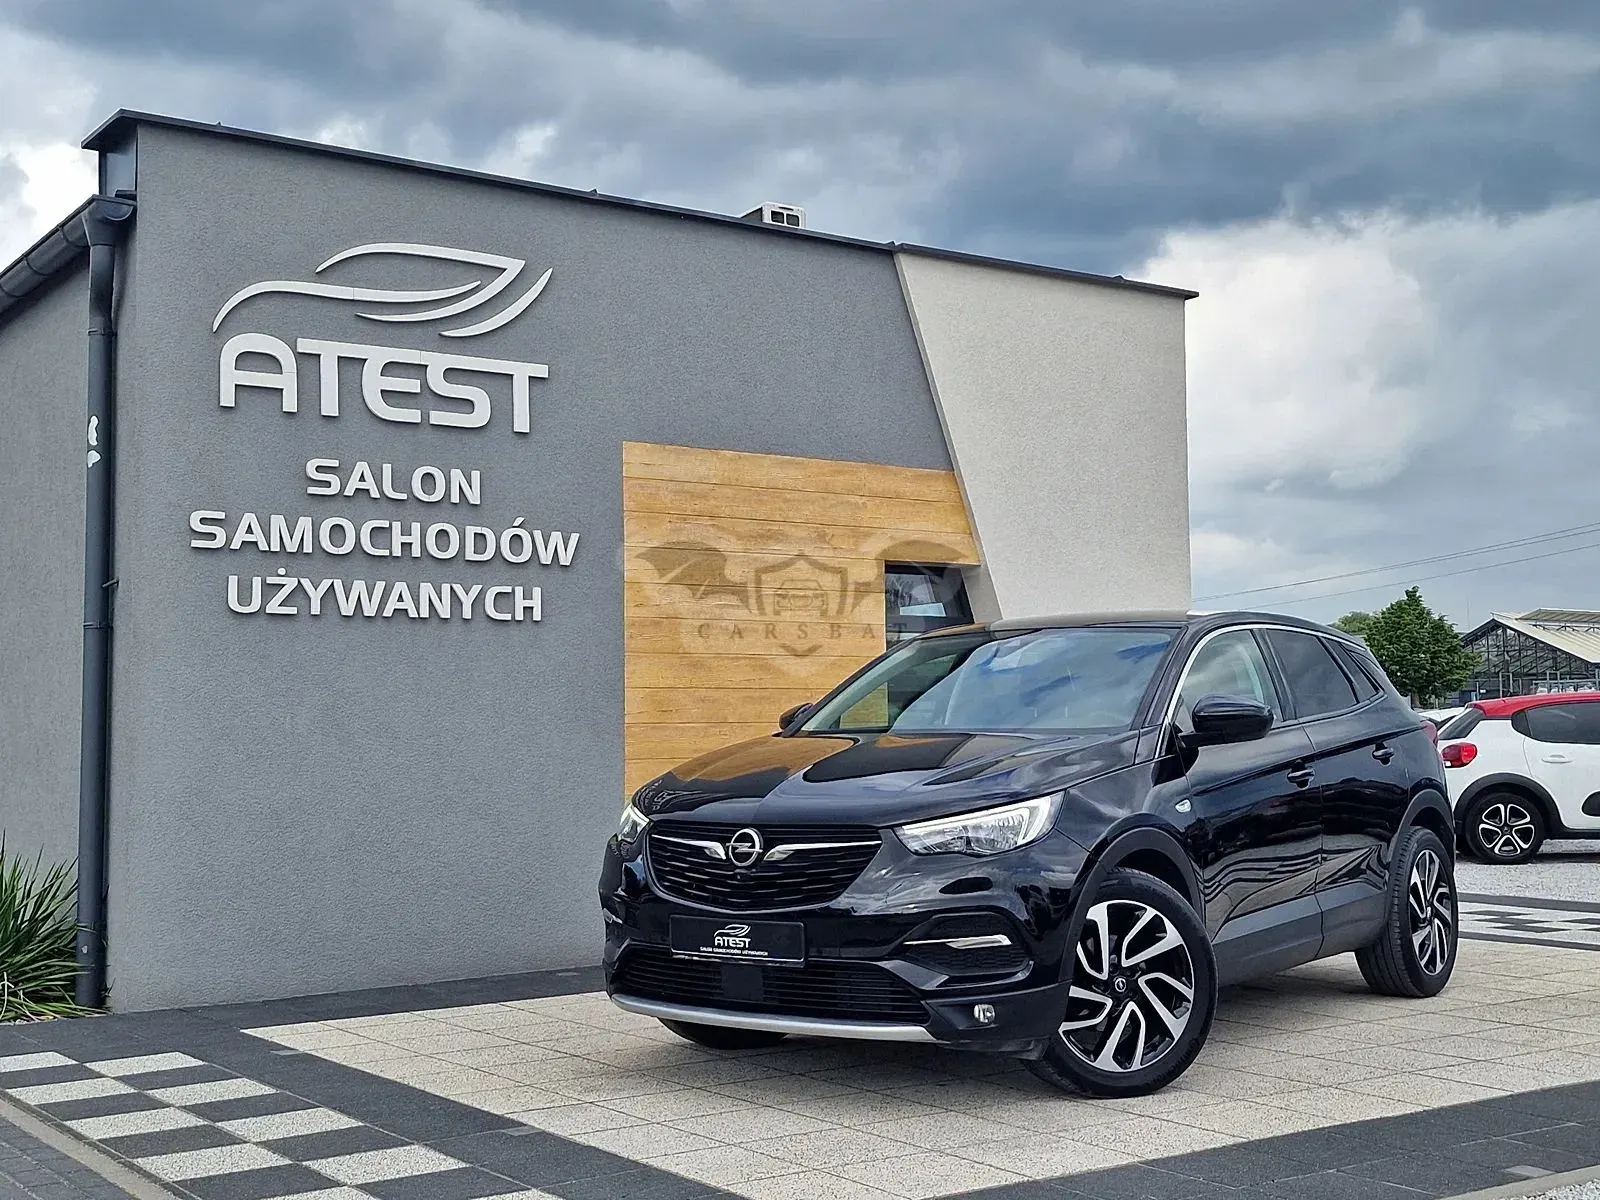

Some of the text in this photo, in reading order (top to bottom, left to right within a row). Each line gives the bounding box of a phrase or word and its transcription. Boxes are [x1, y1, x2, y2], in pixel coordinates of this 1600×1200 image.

[219, 333, 549, 433] ATEST
[305, 458, 481, 504] SALON
[189, 510, 580, 566] SAMOCHODÓW
[227, 568, 541, 621] UŻYWANYCH
[715, 937, 751, 948] ATEST
